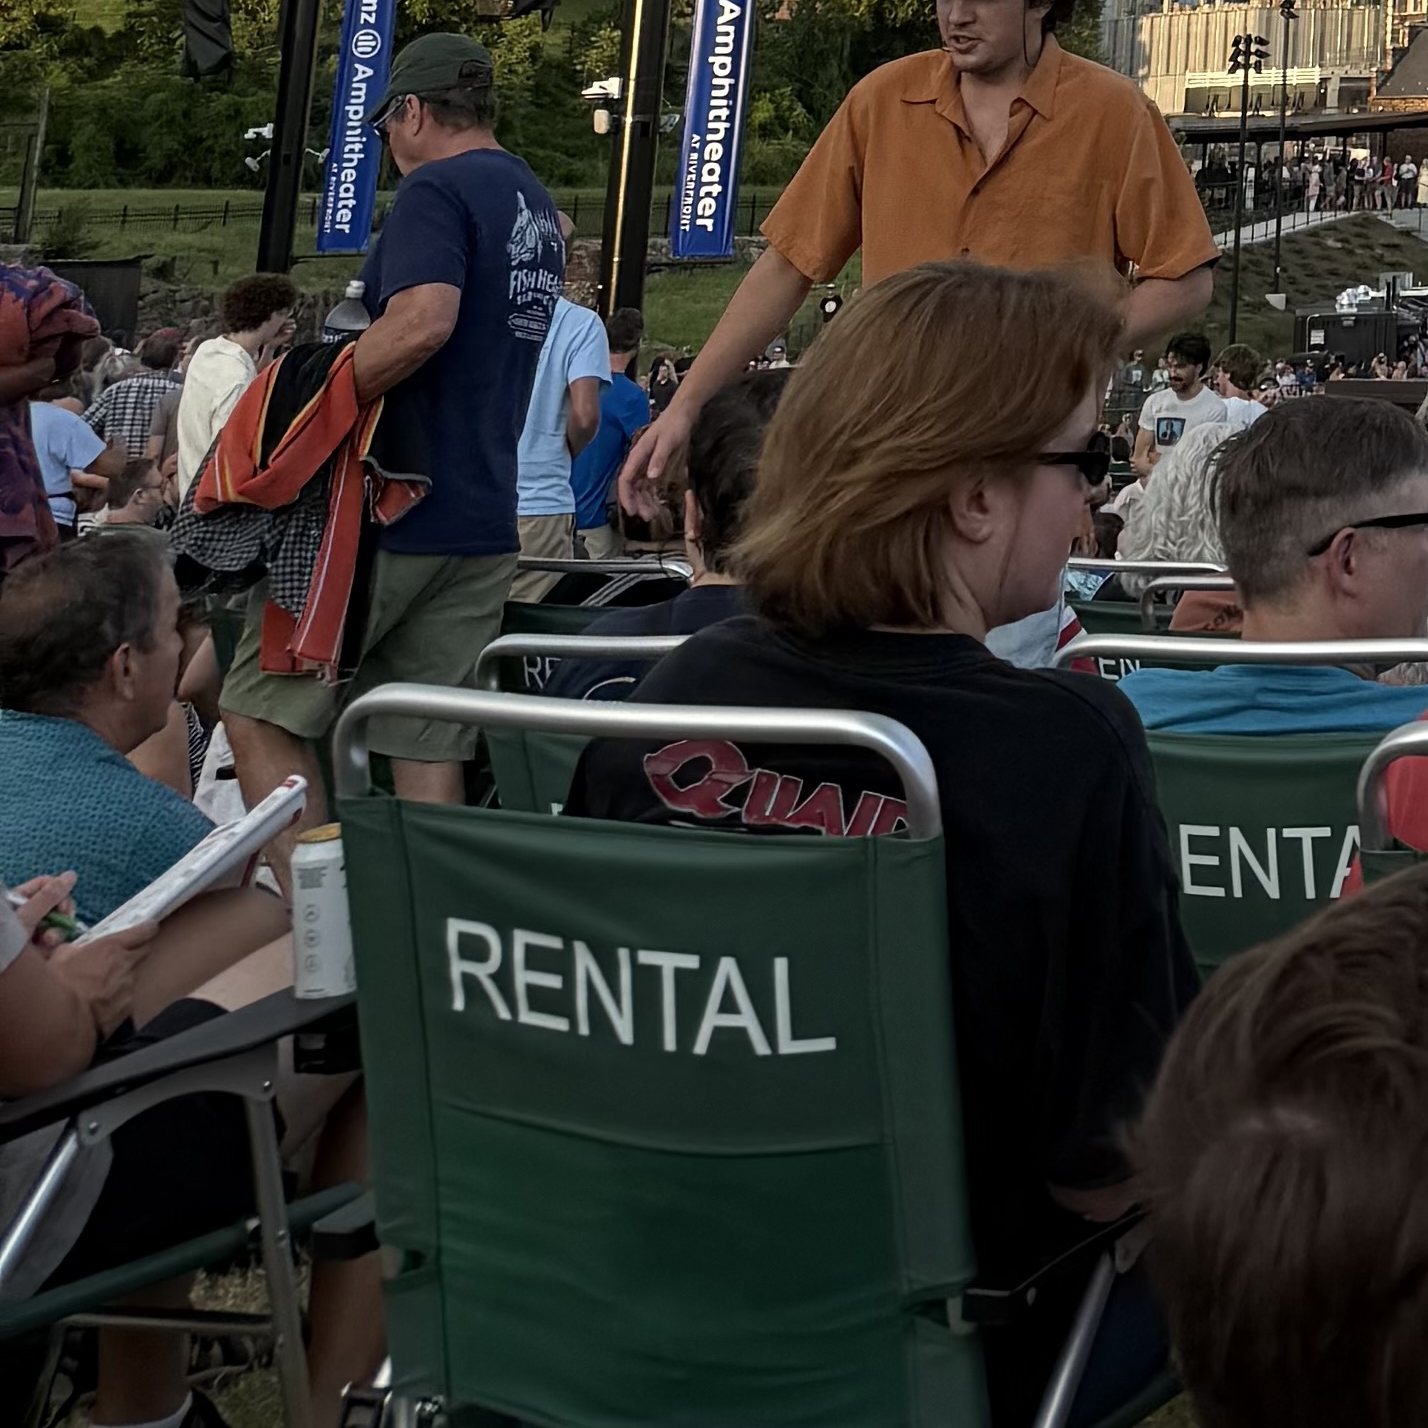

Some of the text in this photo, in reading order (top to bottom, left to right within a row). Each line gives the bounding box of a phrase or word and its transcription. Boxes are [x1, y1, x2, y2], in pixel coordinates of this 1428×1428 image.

[334, 63, 374, 234] Amphitheater
[680, 133, 701, 232] AT RIVERFRONT
[1179, 824, 1361, 900] ENTA
[446, 916, 837, 1056] RENTAL
